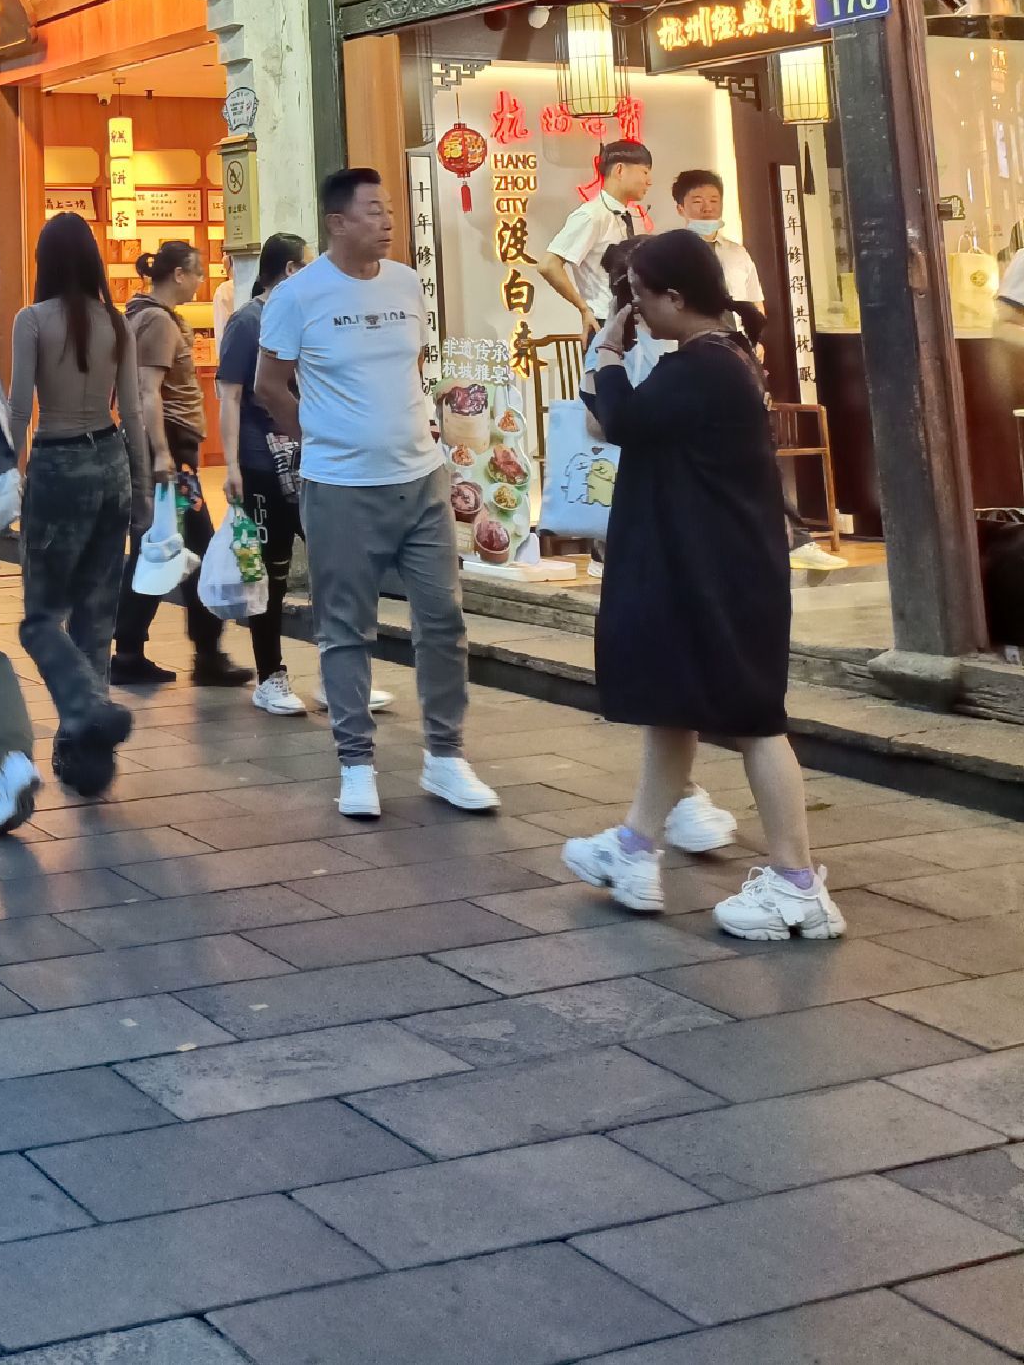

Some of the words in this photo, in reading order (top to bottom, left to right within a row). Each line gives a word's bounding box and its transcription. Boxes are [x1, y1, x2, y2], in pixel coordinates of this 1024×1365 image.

[492, 153, 537, 170] HANG
[493, 175, 538, 191] ZHOU
[495, 197, 529, 214] CITY
